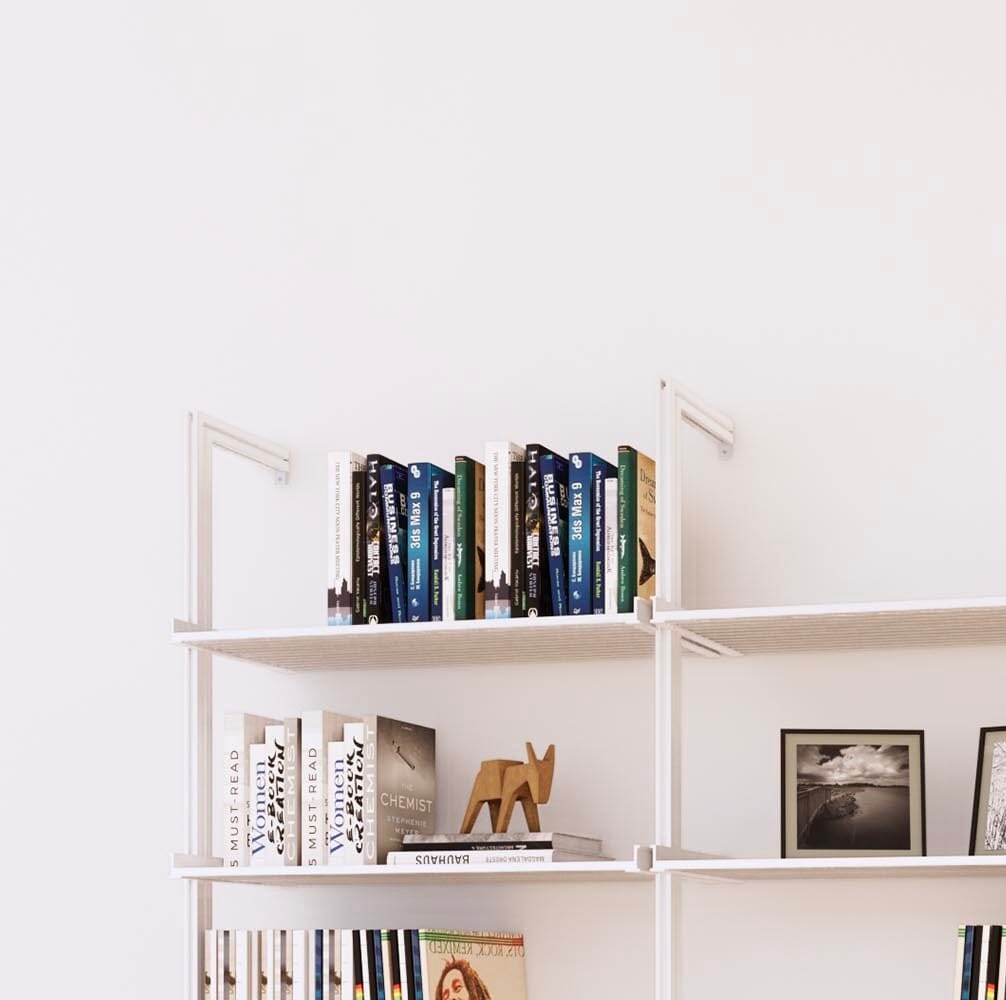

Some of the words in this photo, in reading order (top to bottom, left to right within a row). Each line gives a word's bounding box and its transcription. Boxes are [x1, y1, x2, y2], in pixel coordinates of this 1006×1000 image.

[369, 460, 378, 520] HALO
[410, 491, 421, 499] 9
[410, 502, 421, 526] Max
[528, 450, 538, 510] HALO
[547, 473, 560, 556] BUSINESS
[572, 482, 582, 490] 9
[572, 492, 582, 517] Max
[387, 482, 400, 565] BUSINESS
[410, 528, 421, 549] 3ds
[572, 520, 582, 541] 3ds
[230, 750, 238, 850] MUST-READ
[252, 761, 266, 856] Women
[267, 754, 276, 844] E-BOOK
[275, 737, 285, 855] CREATION
[287, 728, 296, 861] CHEMIST
[308, 748, 317, 848] MUST-READ
[330, 759, 344, 855] Women
[346, 749, 356, 843] E-BOOK
[354, 736, 364, 853] CREATION
[366, 726, 375, 860] CHEMIST
[380, 792, 433, 813] CHEMIST
[401, 783, 413, 791] THE
[230, 859, 238, 867] 5
[416, 854, 470, 864] BAUHAUS
